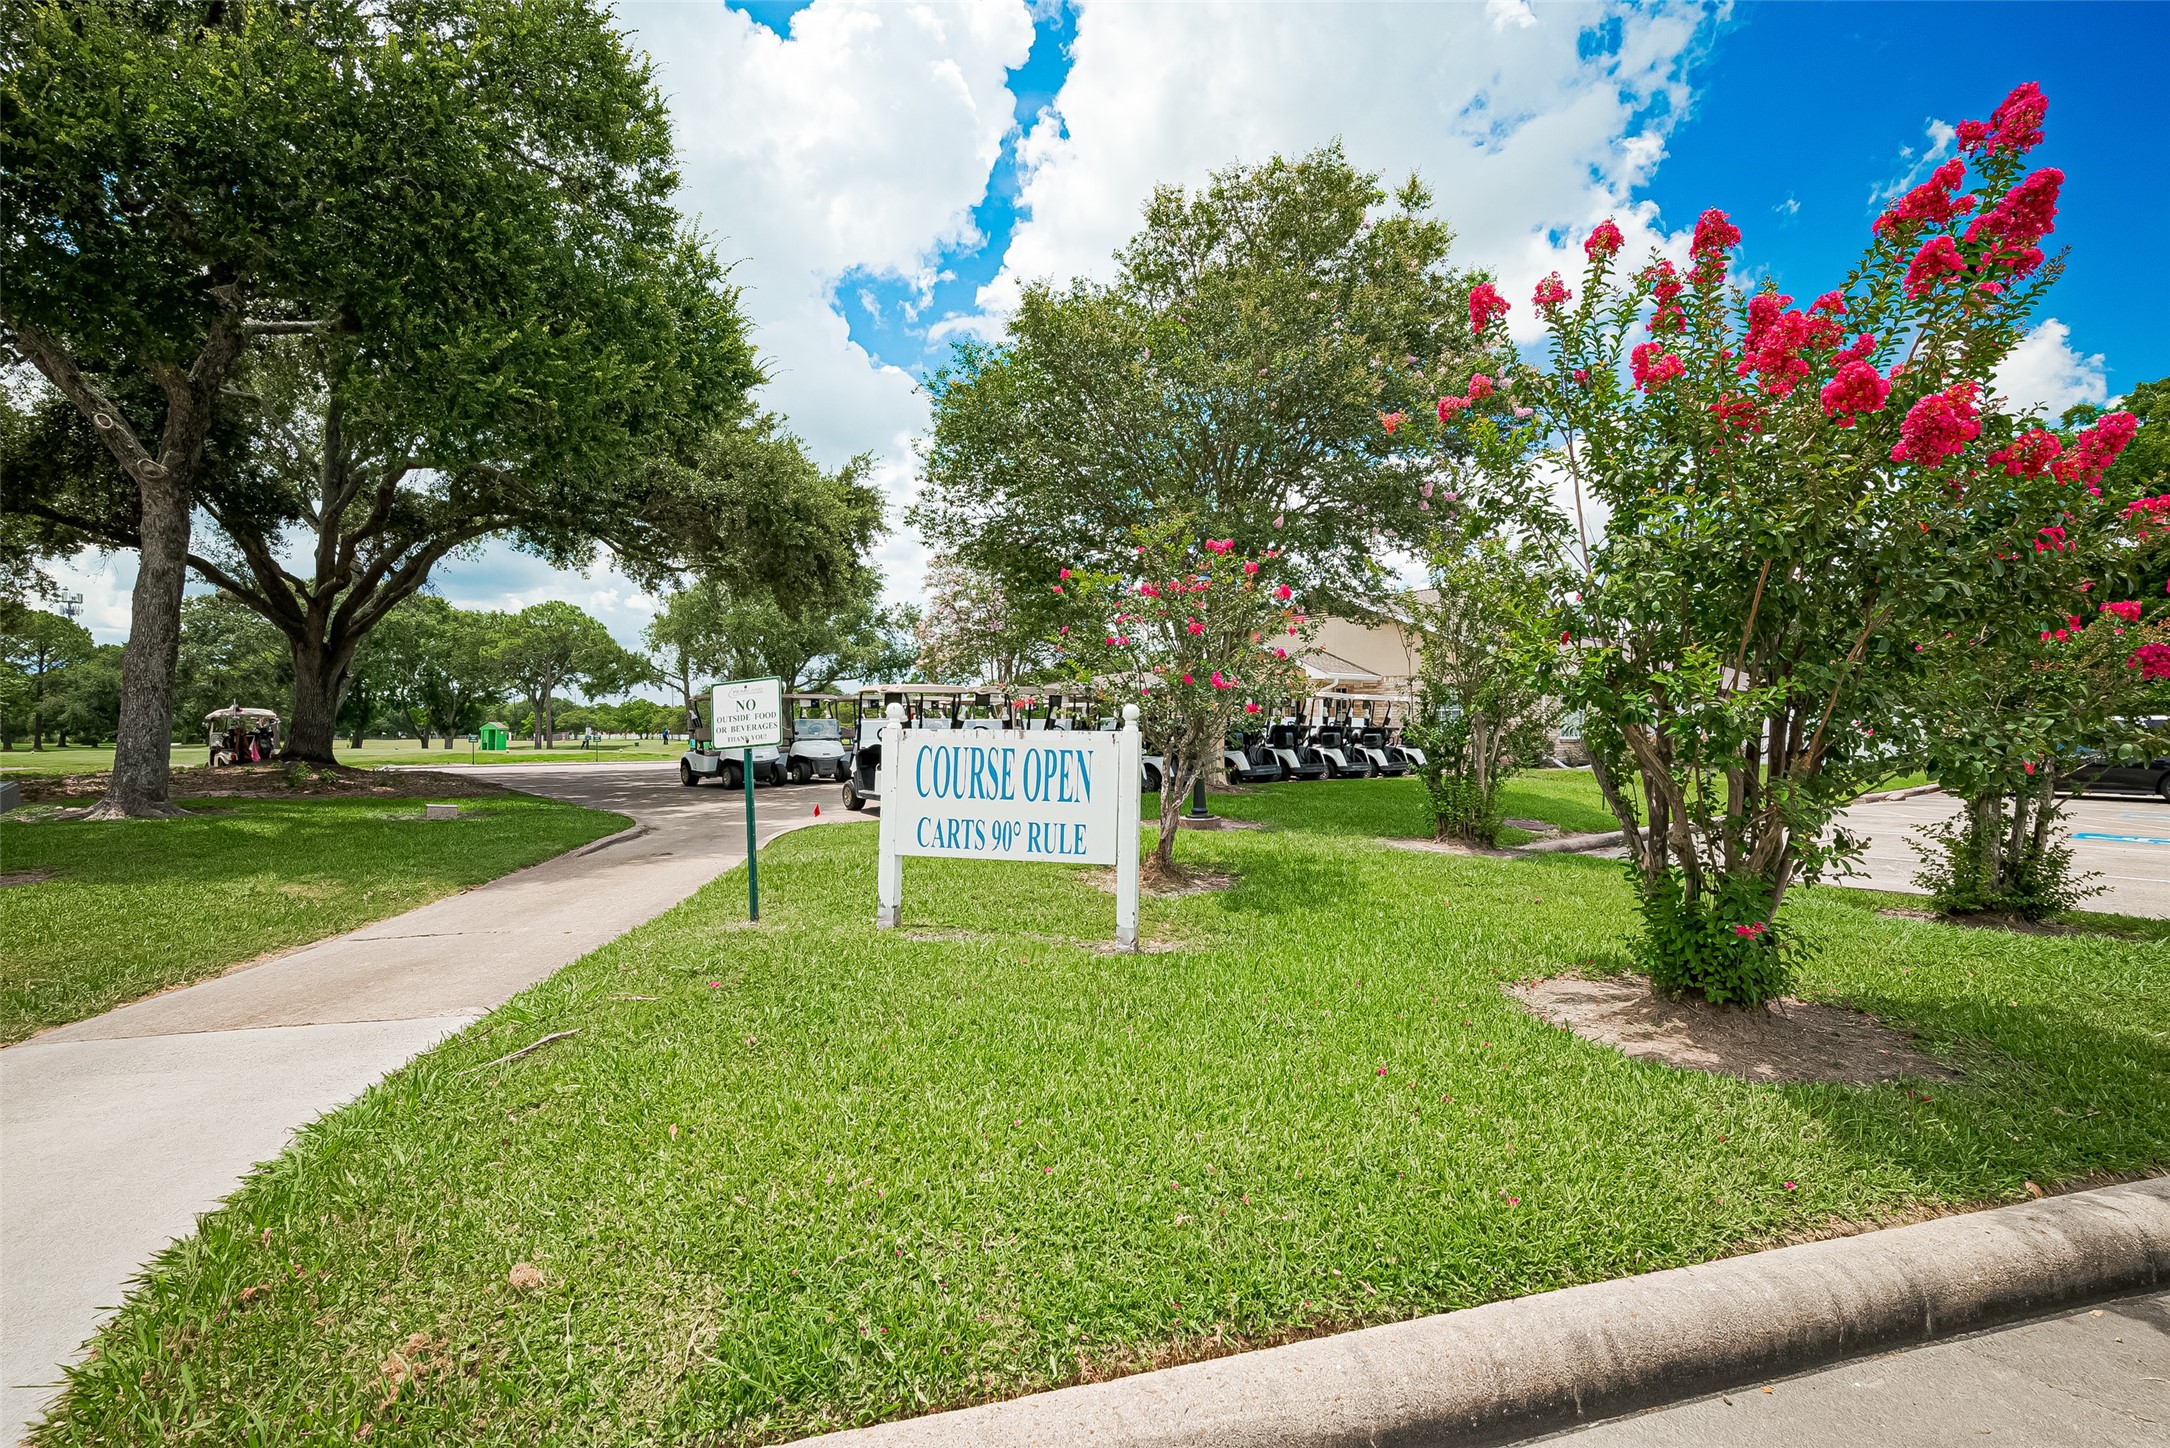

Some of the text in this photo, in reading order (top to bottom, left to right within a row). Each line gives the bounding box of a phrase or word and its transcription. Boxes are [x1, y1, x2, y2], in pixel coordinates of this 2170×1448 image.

[736, 699, 756, 712] NO
[717, 711, 777, 723] OUTSIDE FOOD
[731, 722, 778, 732] BEVERAGES
[915, 744, 1094, 804] COURSE OPEN
[916, 816, 986, 851] CARTS
[1026, 821, 1087, 855] RULE
